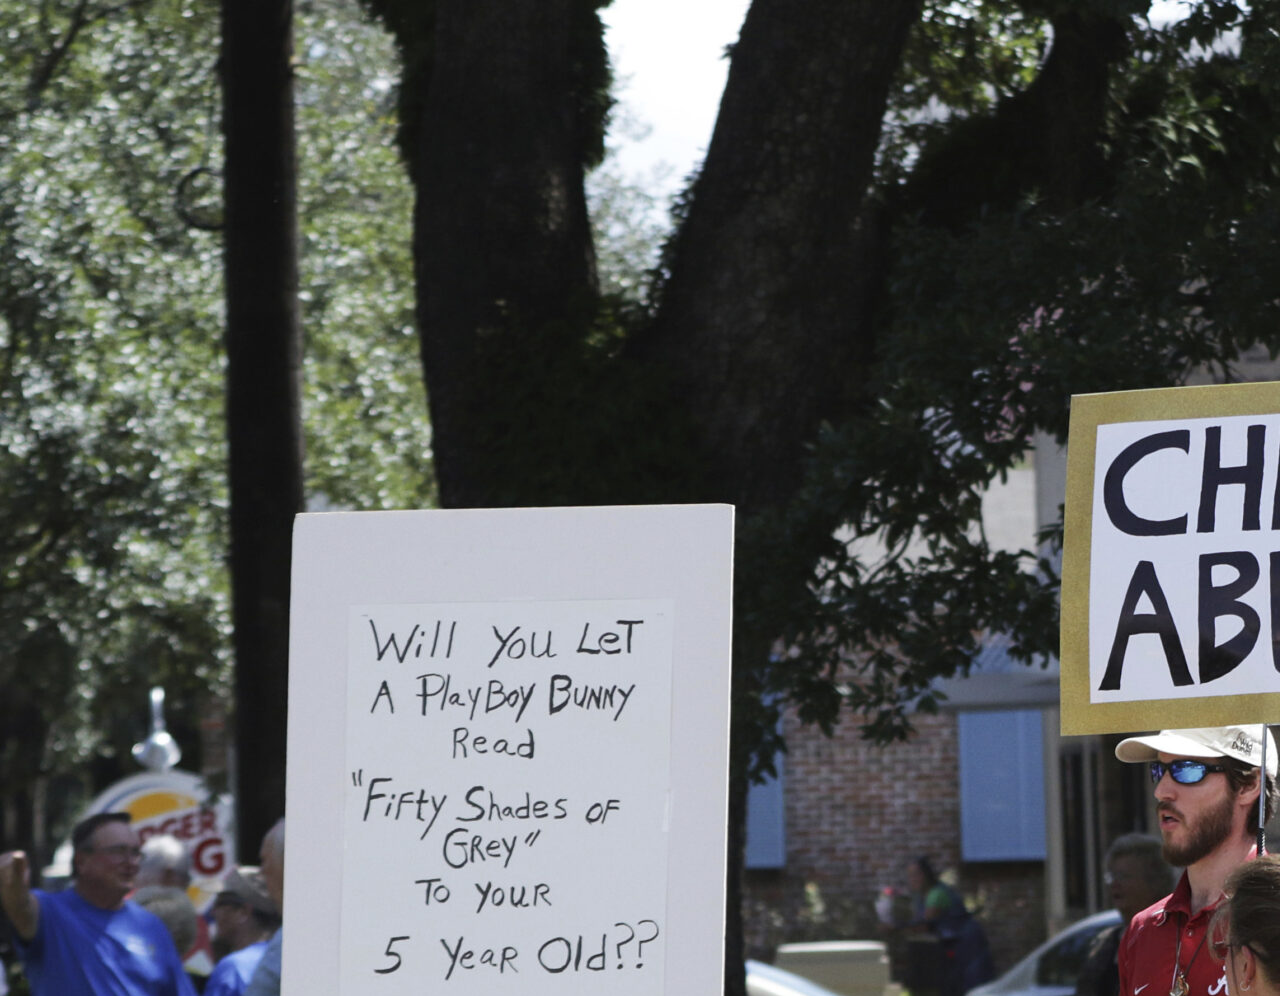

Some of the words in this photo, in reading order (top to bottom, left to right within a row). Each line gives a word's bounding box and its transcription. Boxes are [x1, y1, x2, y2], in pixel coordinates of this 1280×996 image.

[369, 619, 457, 664] Will
[487, 625, 558, 668] You
[370, 679, 395, 715] A
[415, 673, 537, 723] PlayBoy
[548, 673, 636, 722] BUNNY
[452, 726, 535, 760] Read
[455, 785, 568, 822] Shades
[373, 935, 411, 975] 5
[537, 919, 660, 974] Old??
